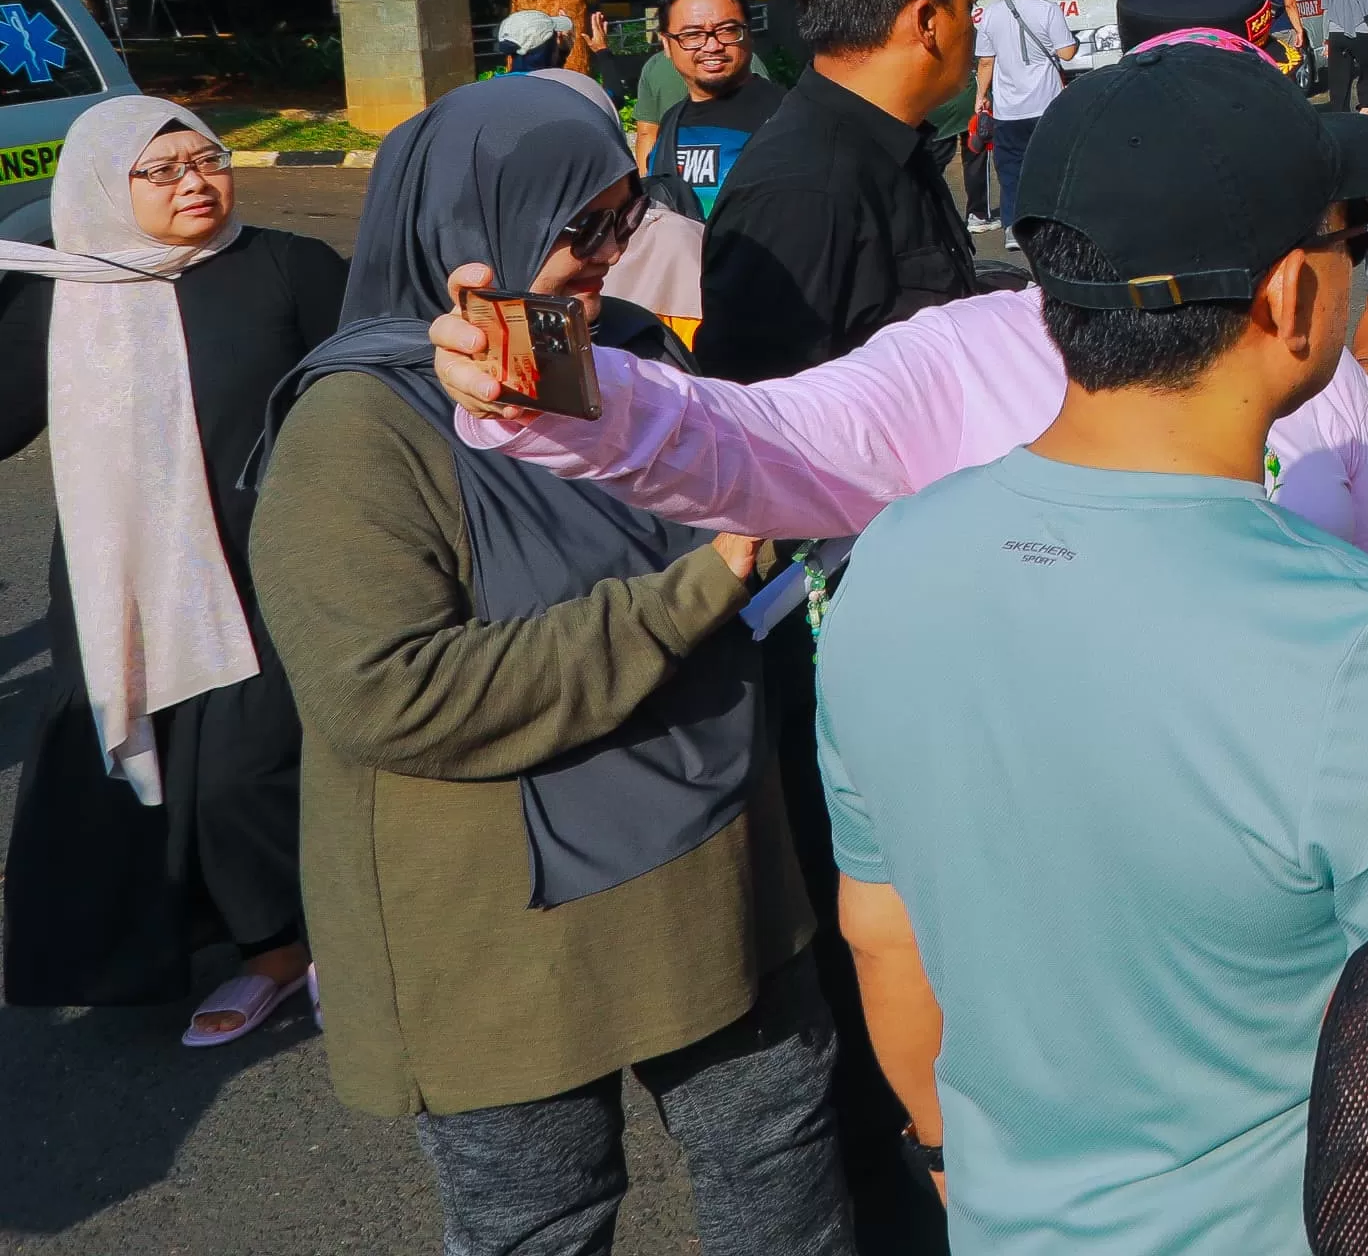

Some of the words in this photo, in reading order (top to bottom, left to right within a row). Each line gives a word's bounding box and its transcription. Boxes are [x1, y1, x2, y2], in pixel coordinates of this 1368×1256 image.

[0, 144, 64, 182] NSP
[1001, 540, 1076, 561] SKECHERS
[1021, 554, 1056, 566] SPORT
